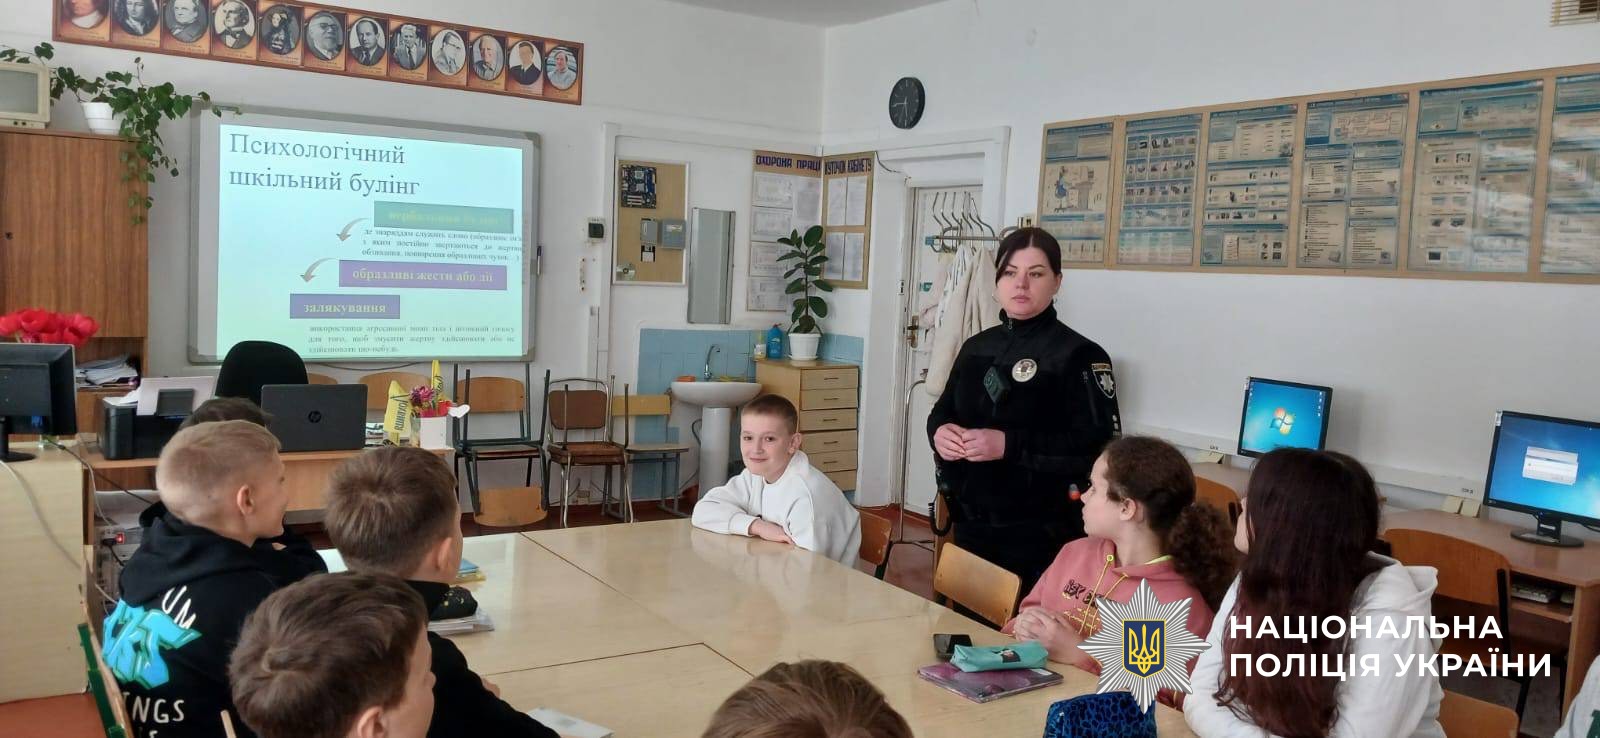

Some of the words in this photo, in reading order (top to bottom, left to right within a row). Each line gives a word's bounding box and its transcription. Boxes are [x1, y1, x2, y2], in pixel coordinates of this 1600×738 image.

[229, 132, 405, 165] Психологічний
[755, 154, 792, 169] ОХОРОНА
[796, 159, 821, 172] ПРАЦІ
[847, 157, 872, 174] КАБІНЕТУ
[228, 166, 342, 192] шкільний
[349, 173, 420, 197] булінг
[352, 267, 414, 281] образливі
[416, 270, 453, 281] жести
[456, 270, 476, 282] або
[303, 301, 386, 316] залякування
